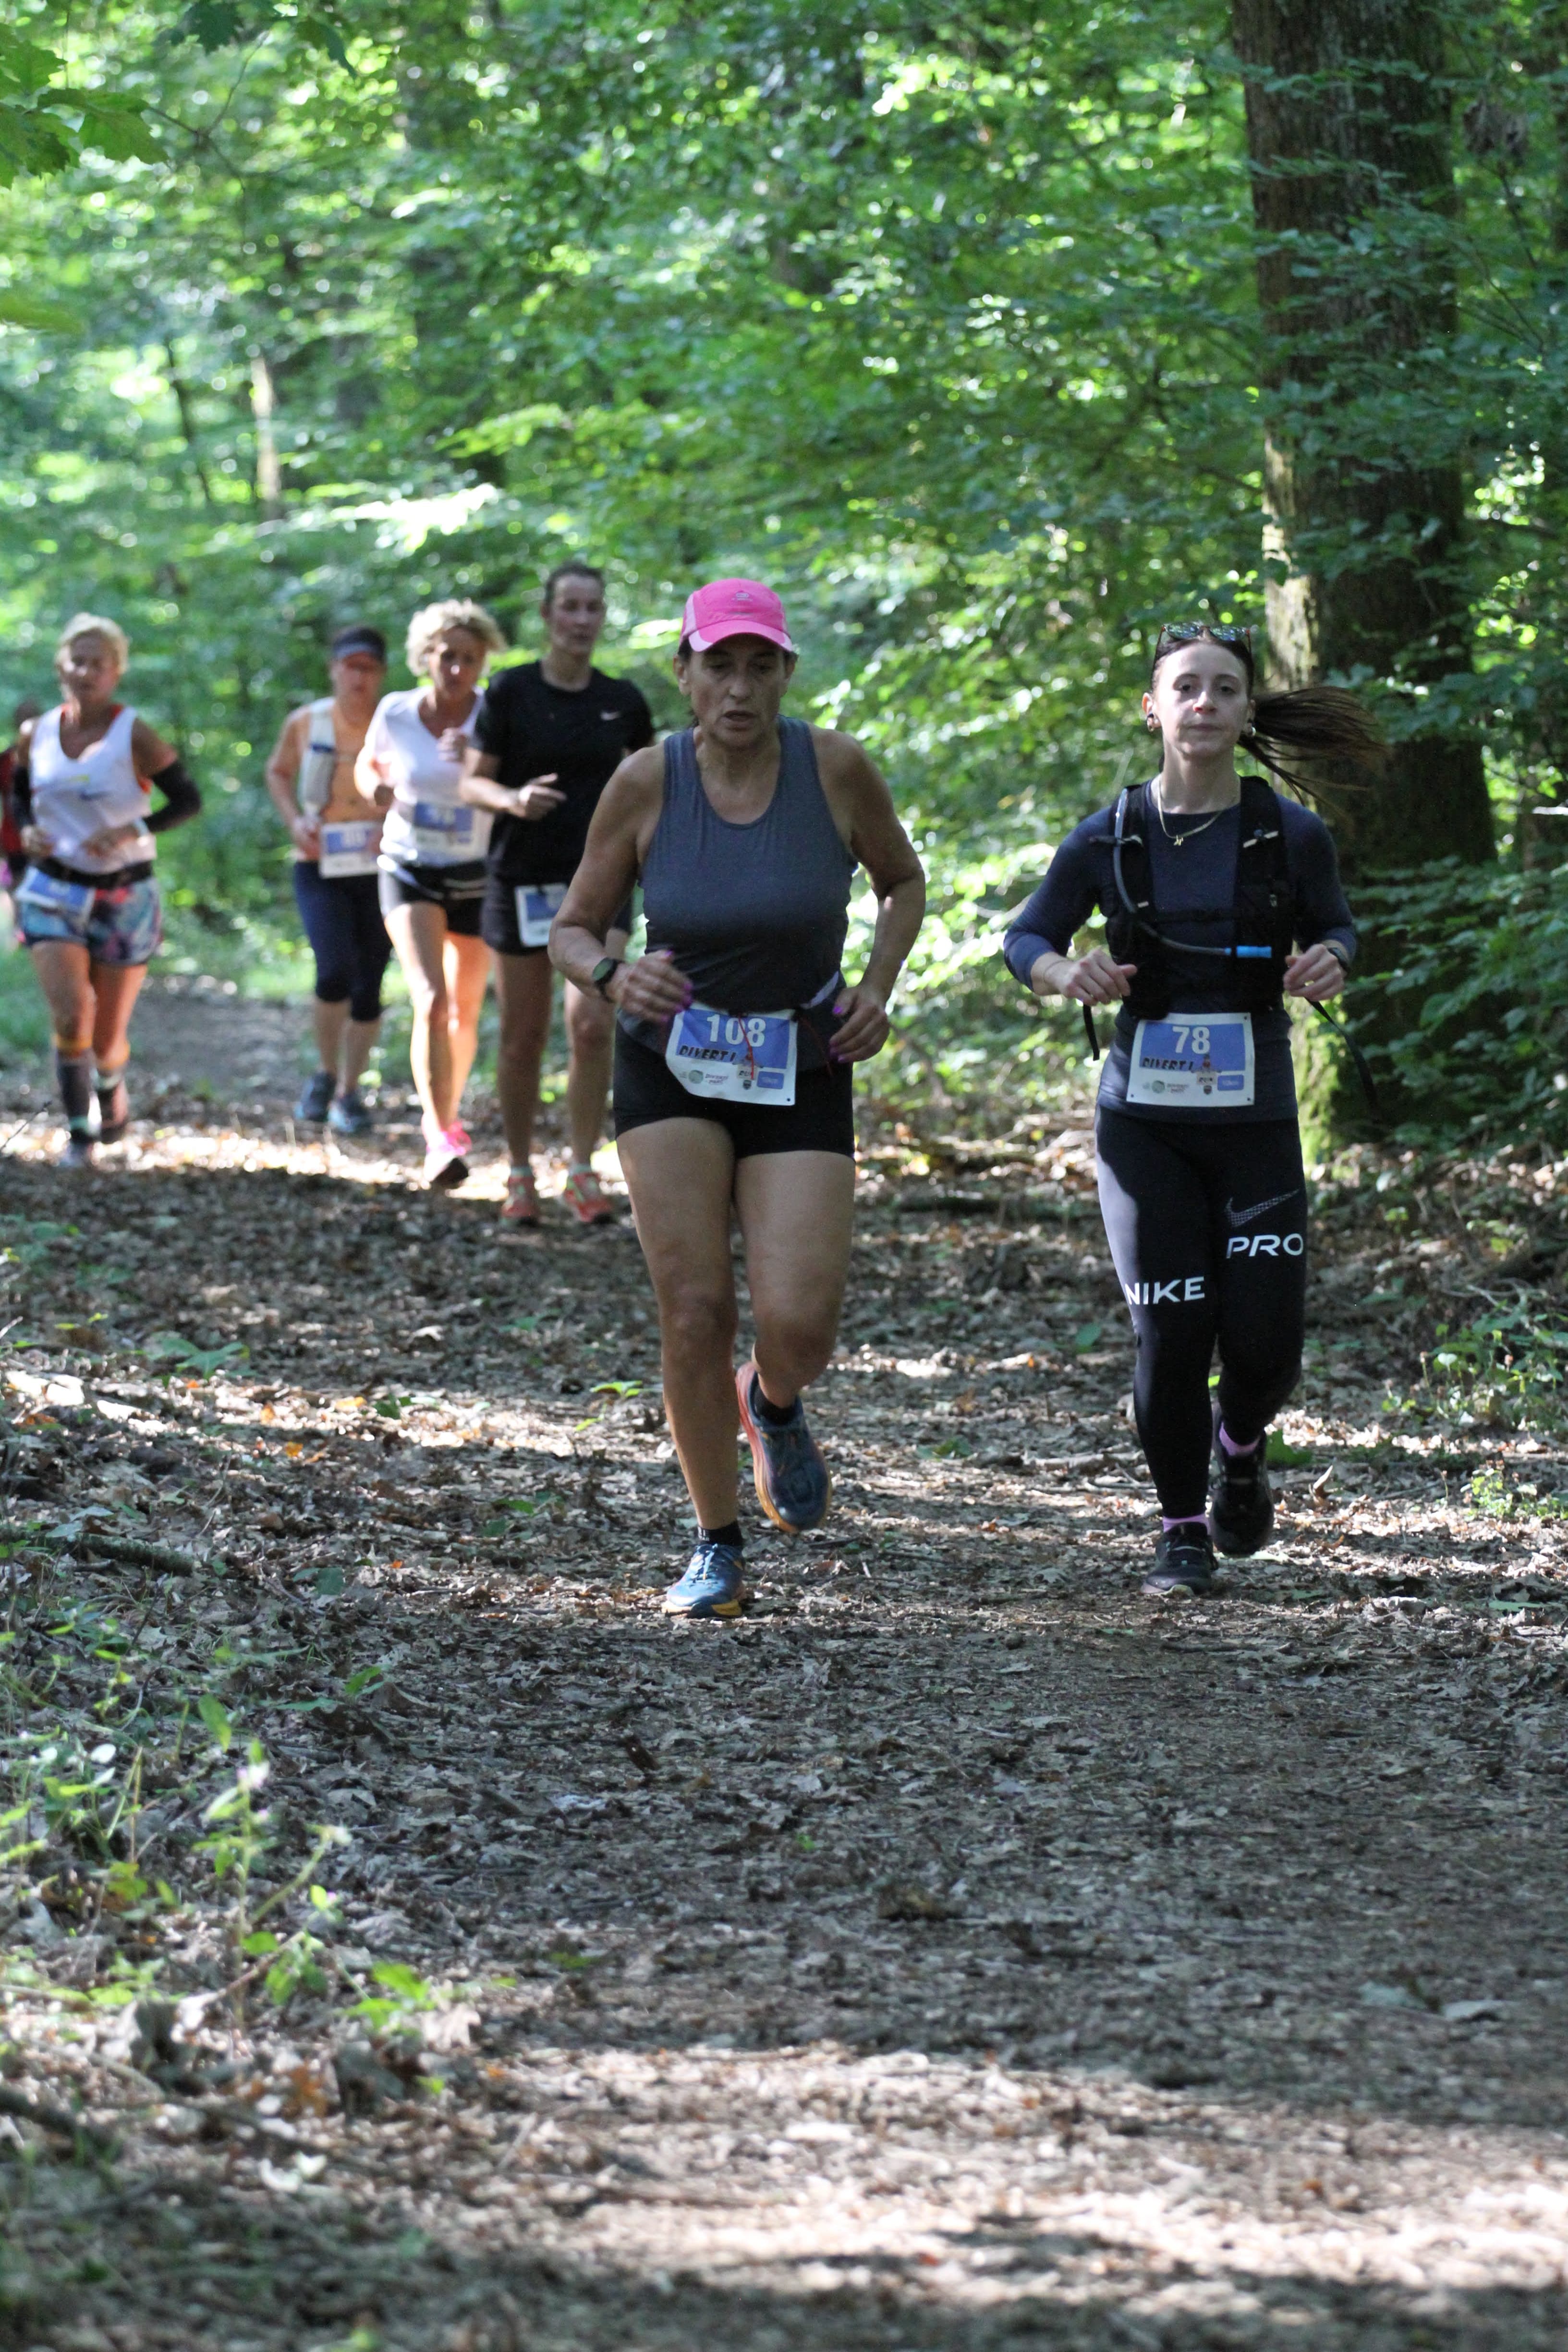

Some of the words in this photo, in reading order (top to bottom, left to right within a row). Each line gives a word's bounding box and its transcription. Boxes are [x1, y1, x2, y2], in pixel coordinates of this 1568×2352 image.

[707, 1014, 766, 1047] 108
[1172, 1026, 1210, 1054] 78
[1226, 1233, 1303, 1259] PRO
[1124, 1276, 1205, 1305] NIKE
